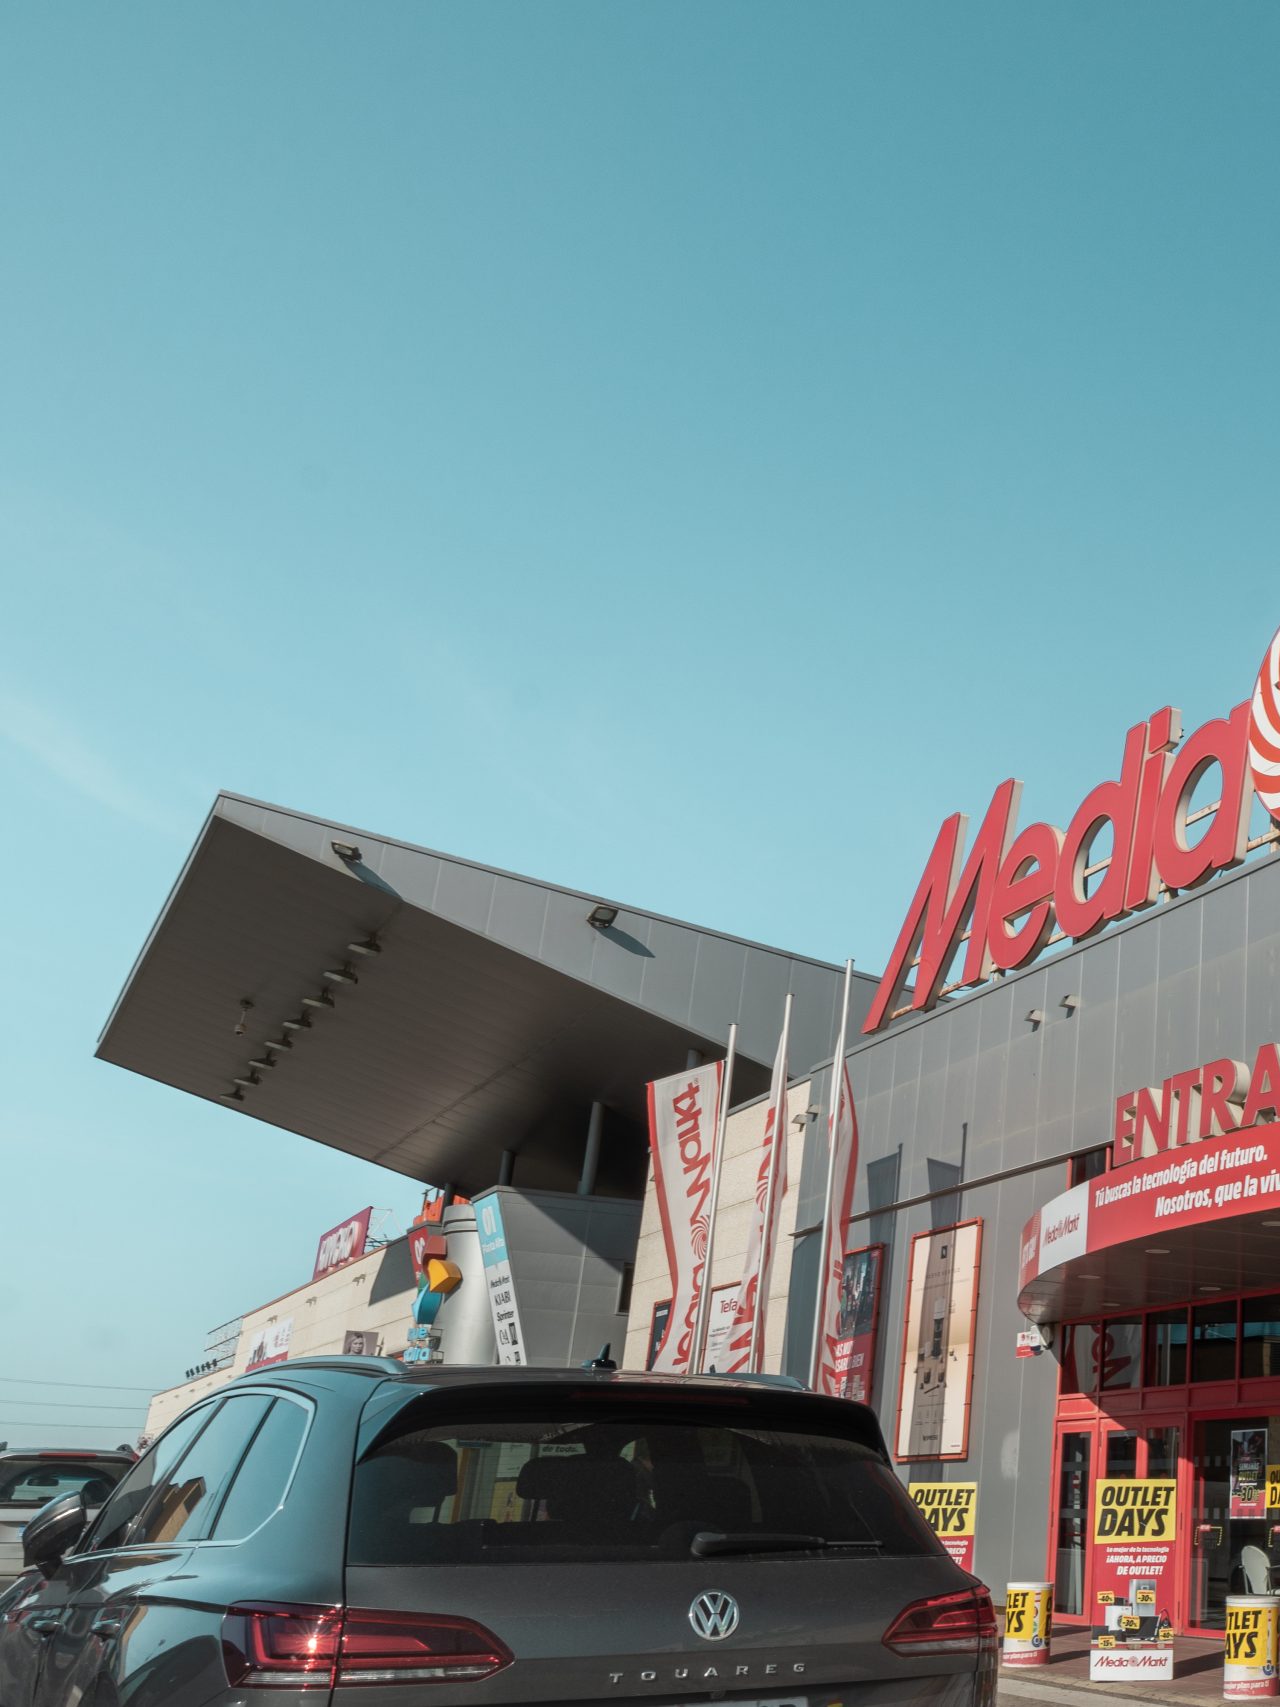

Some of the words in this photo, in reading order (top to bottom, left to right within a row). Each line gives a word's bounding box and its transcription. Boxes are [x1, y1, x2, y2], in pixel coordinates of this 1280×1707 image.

[861, 706, 1256, 1036] Media
[1095, 1188, 1104, 1208] Tú
[1104, 1178, 1132, 1204] buscas
[1132, 1175, 1141, 1194] la
[1142, 1160, 1197, 1193] tecnología
[1199, 1152, 1220, 1175] del
[1220, 1144, 1268, 1171] futuro.
[1155, 1187, 1213, 1218] Nosotros,
[1215, 1180, 1242, 1208] que
[1244, 1174, 1259, 1198] la
[720, 1297, 737, 1313] Tefa
[914, 1488, 975, 1506] OUTLET
[1101, 1486, 1175, 1506] OUTLET
[1097, 1508, 1169, 1537] DAYS
[1142, 1555, 1167, 1563] PRECIO
[1116, 1566, 1129, 1575] DE
[1129, 1566, 1163, 1575] OUTLET!
[1007, 1592, 1029, 1609] LET
[1006, 1610, 1025, 1633] YS
[1227, 1609, 1262, 1631] TLET
[1225, 1632, 1258, 1660] AYS
[1094, 1656, 1128, 1667] Media
[1136, 1656, 1168, 1667] Markt
[609, 1663, 806, 1684] TOUAREG
